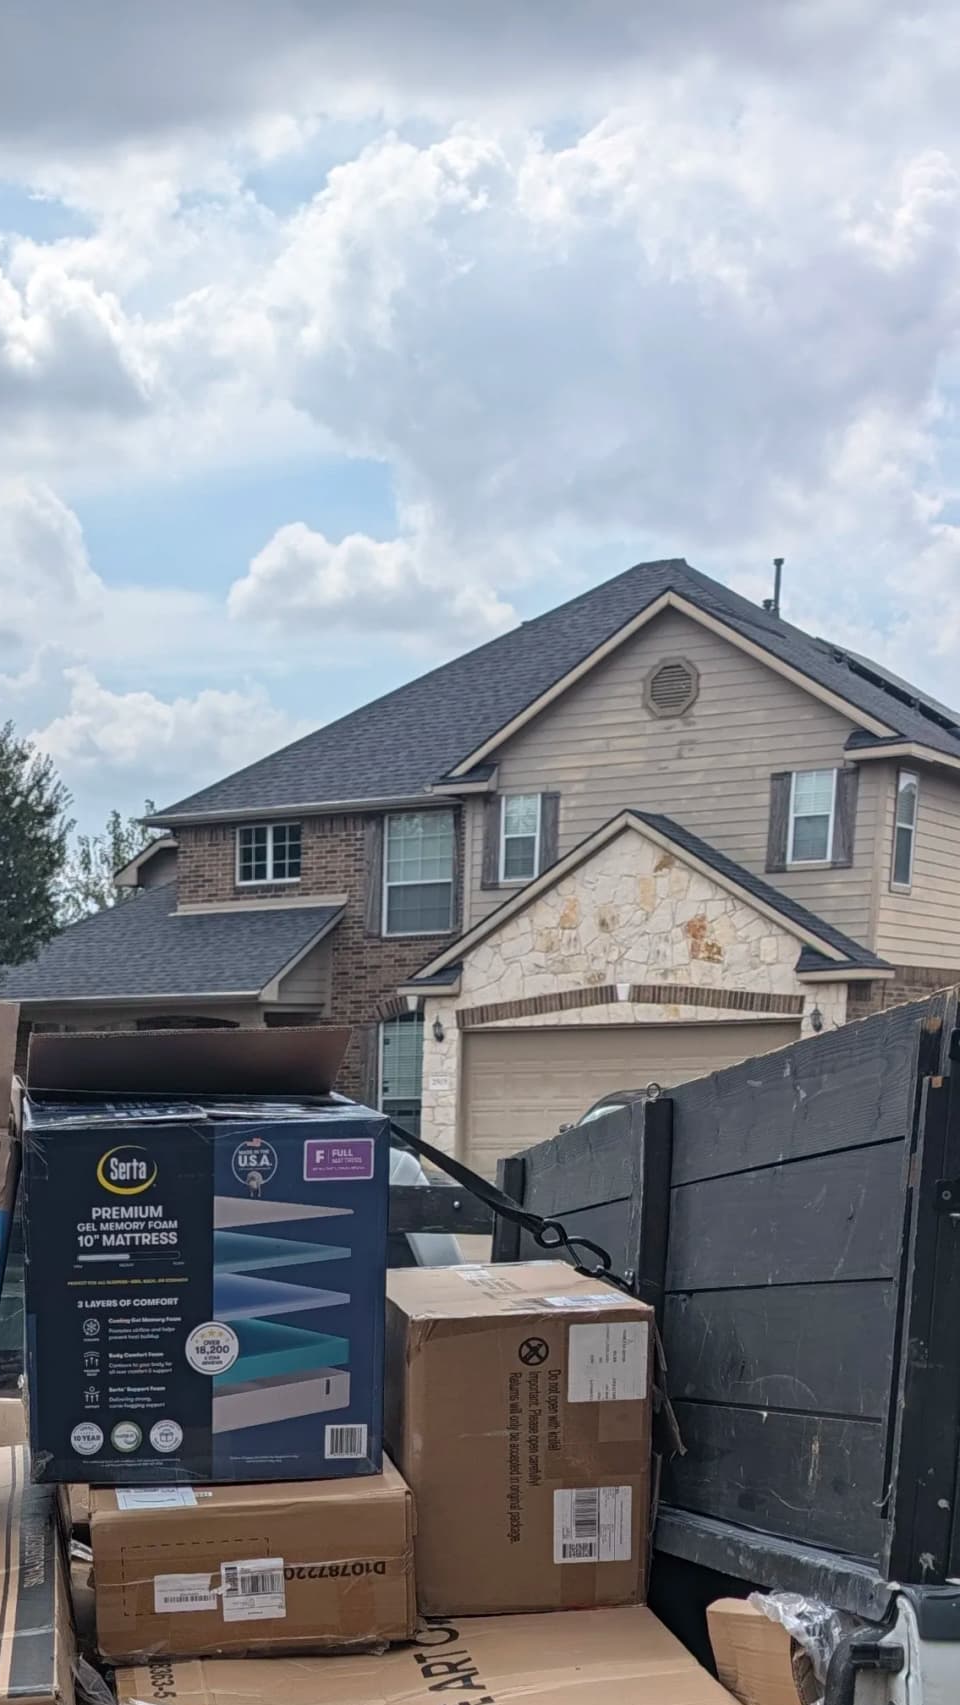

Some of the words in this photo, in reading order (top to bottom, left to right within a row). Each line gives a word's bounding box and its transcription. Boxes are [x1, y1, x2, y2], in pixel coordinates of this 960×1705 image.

[238, 1154, 273, 1167] U.S.A.
[315, 1150, 325, 1164] F
[331, 1149, 354, 1157] FULL
[109, 1157, 148, 1181] Serta
[91, 1205, 163, 1220] PREMIUM
[77, 1223, 97, 1233] GEL
[100, 1221, 146, 1232] MEMORY
[148, 1220, 178, 1230] FOAM
[77, 1234, 100, 1248] 10"
[102, 1232, 178, 1247] MATTRESS
[77, 1300, 84, 1308] 3
[85, 1299, 118, 1308] LAYERS
[119, 1299, 132, 1307] OF
[133, 1298, 179, 1306] COMFORT
[195, 1345, 230, 1355] 18,200
[548, 1369, 561, 1381] Do
[509, 1371, 522, 1402] Returns
[548, 1381, 560, 1395] not
[509, 1402, 522, 1415] will
[545, 1395, 558, 1415] open
[506, 1415, 522, 1431] only
[528, 1409, 541, 1434] Please
[548, 1415, 560, 1430] with
[509, 1432, 522, 1442] be
[525, 1435, 538, 1454] open
[507, 1443, 522, 1475] accepted
[506, 1485, 523, 1512] original
[505, 1512, 523, 1545] package.
[413, 1649, 487, 1692] ART
